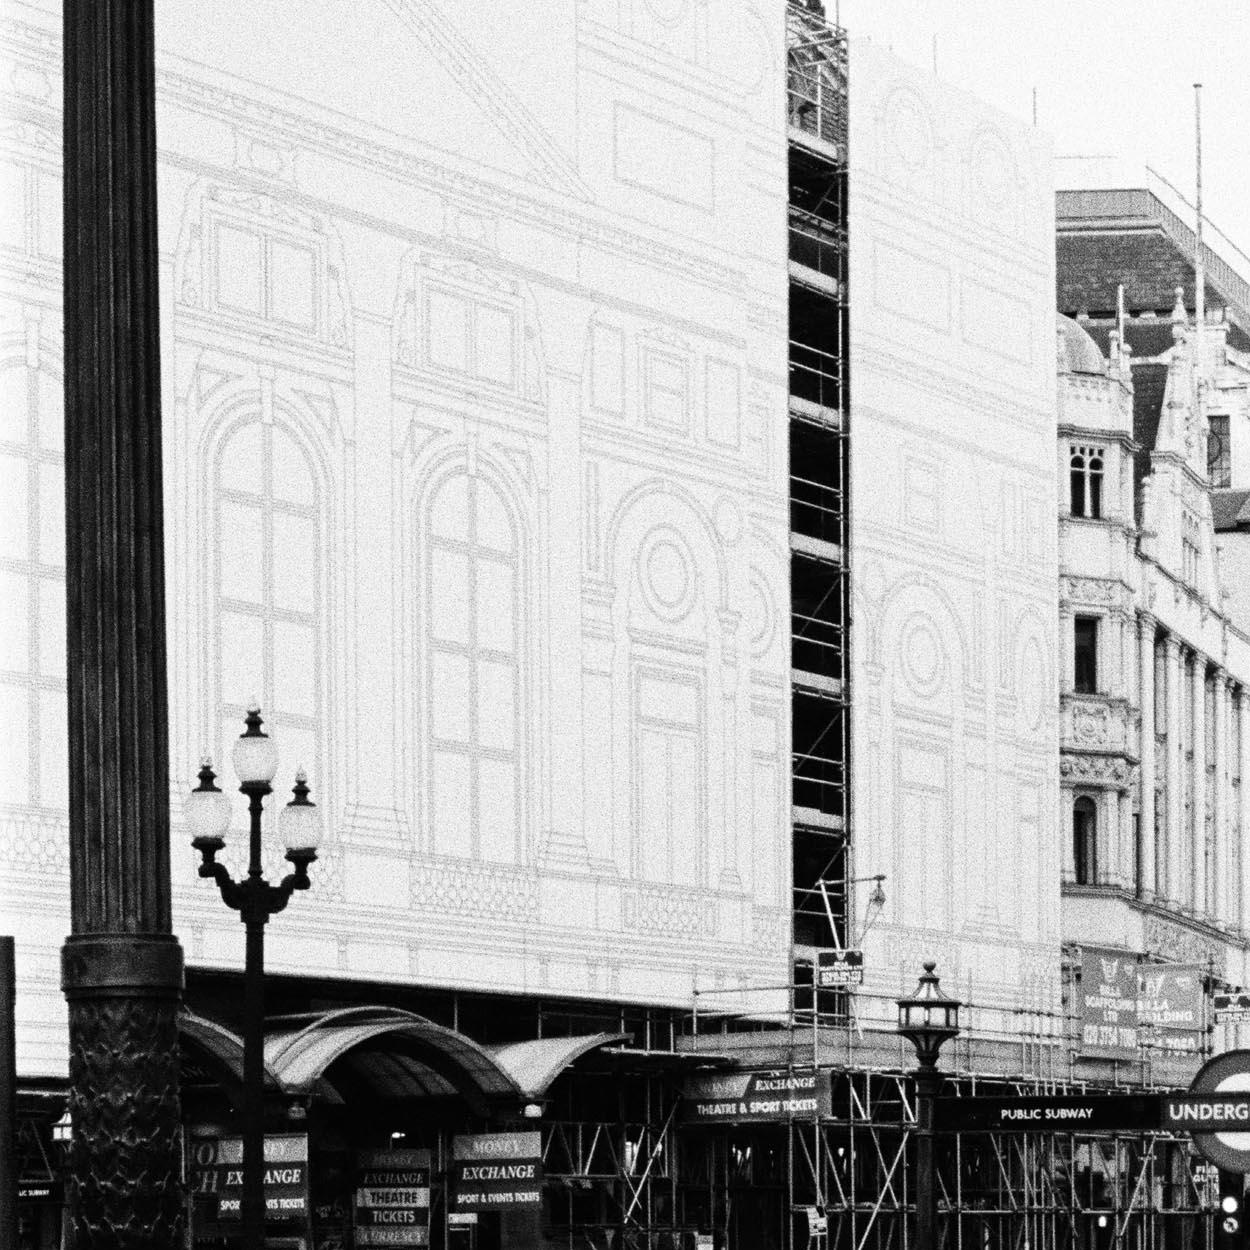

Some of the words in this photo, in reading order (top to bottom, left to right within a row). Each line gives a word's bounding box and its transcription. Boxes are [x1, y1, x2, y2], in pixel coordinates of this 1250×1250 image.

[755, 1077, 816, 1091] EXCHANGE
[697, 1103, 737, 1115] THEATRE
[739, 1102, 748, 1114] &
[750, 1101, 780, 1113] SPORT
[782, 1099, 818, 1111] TICKETS
[1001, 1108, 1042, 1120] PUBLIC
[1045, 1107, 1094, 1120] SUBWAY
[226, 1169, 301, 1185] EXANGE
[364, 1172, 424, 1185] EXCHANGE
[462, 1165, 536, 1181] EXCHANGE
[370, 1190, 418, 1204] THEATRE
[457, 1193, 479, 1204] SPORT
[488, 1192, 514, 1203] EVENTS
[515, 1191, 540, 1202] TICKETS
[220, 1199, 241, 1211] SPOR
[372, 1210, 416, 1223] TICKETS
